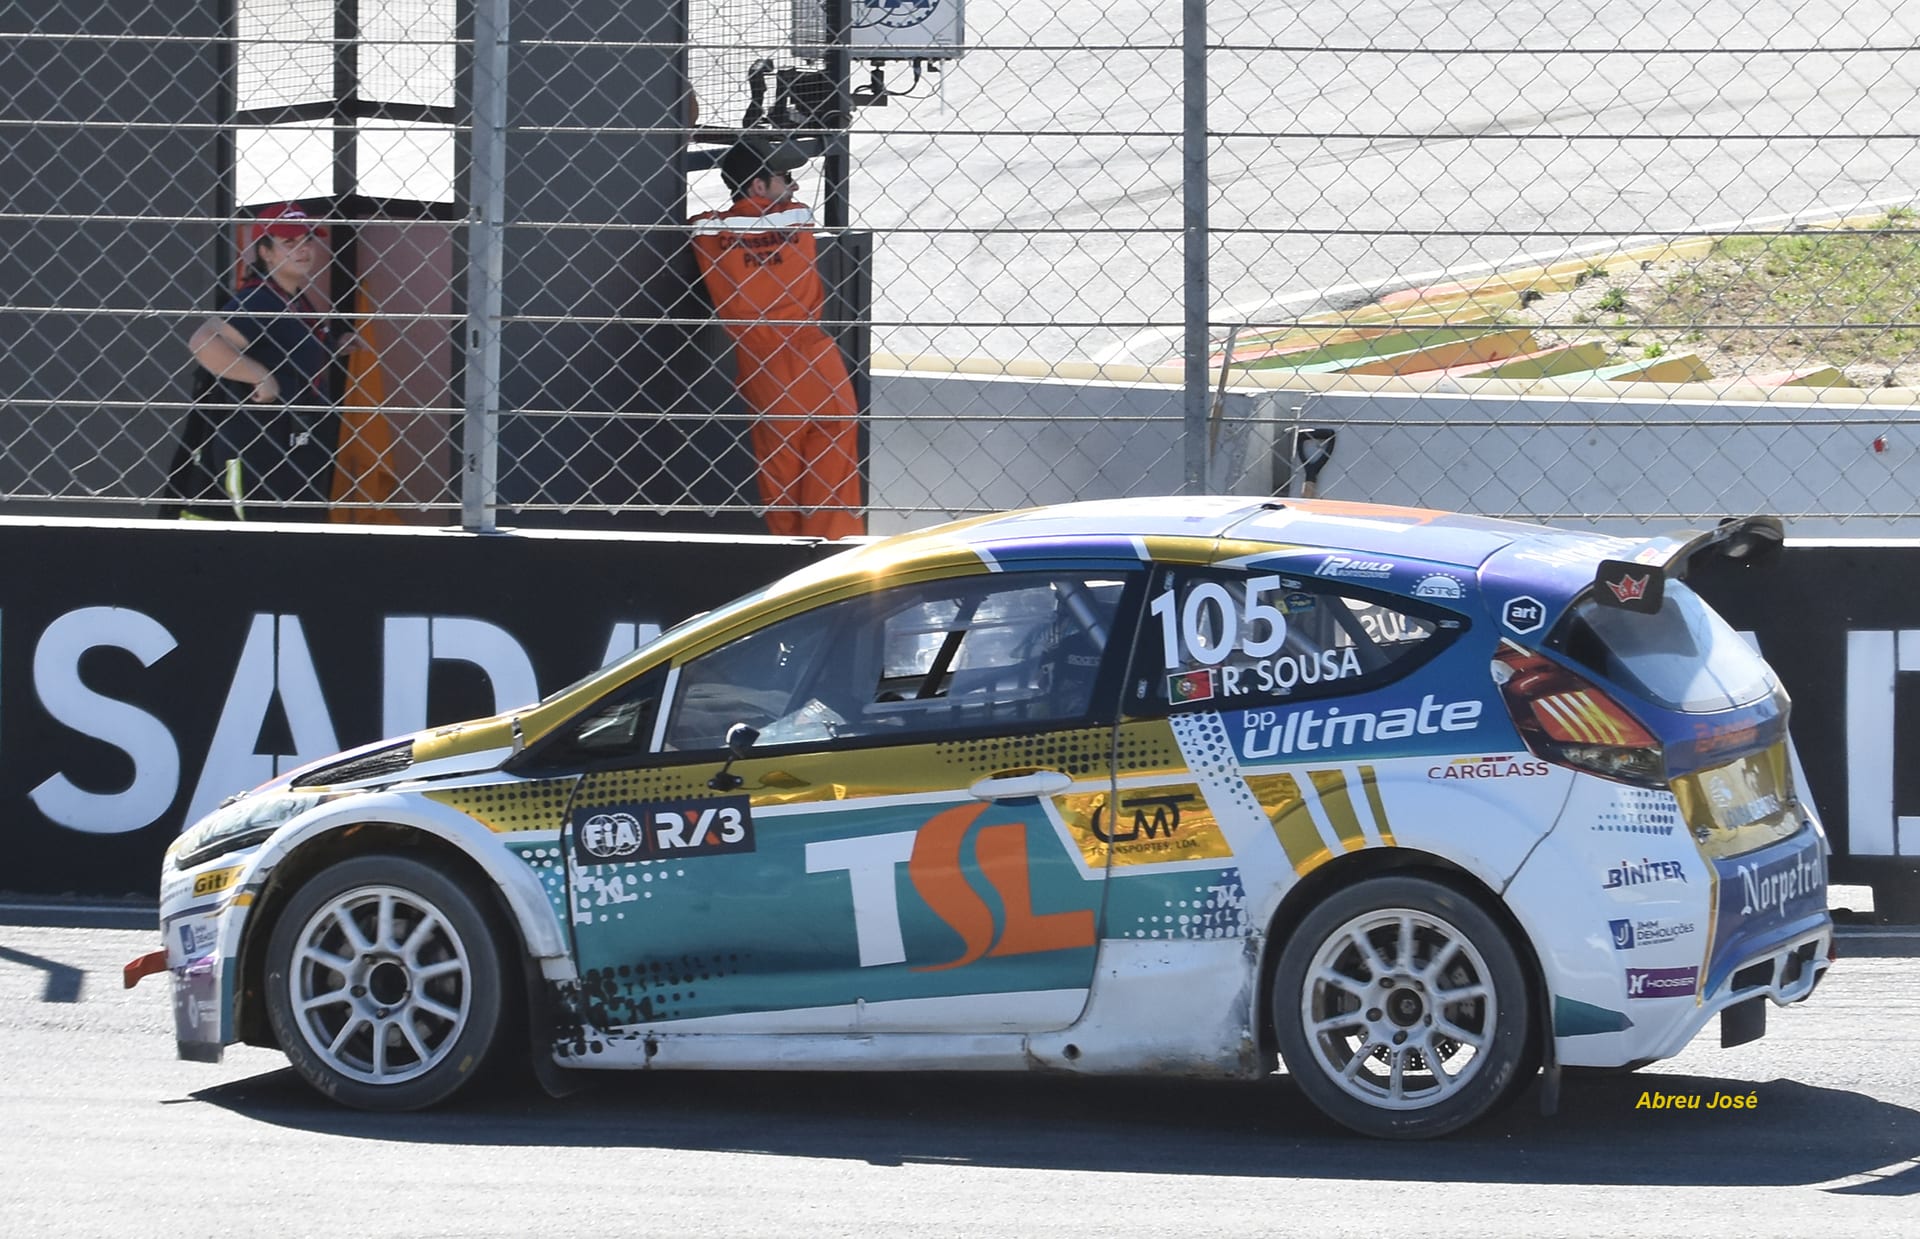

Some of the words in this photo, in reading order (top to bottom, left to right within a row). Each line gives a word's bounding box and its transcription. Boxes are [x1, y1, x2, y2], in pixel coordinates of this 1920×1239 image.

[1150, 575, 1287, 669] 105
[1510, 605, 1538, 619] art
[1221, 666, 1249, 697] R.
[1256, 647, 1363, 692] SOUSA
[1243, 710, 1277, 731] bp
[1427, 761, 1549, 780] CARGLASS
[655, 807, 745, 850] RX3
[194, 872, 230, 894] Giti
[805, 800, 1097, 973] TSL
[1646, 978, 1696, 989] HOOSIER
